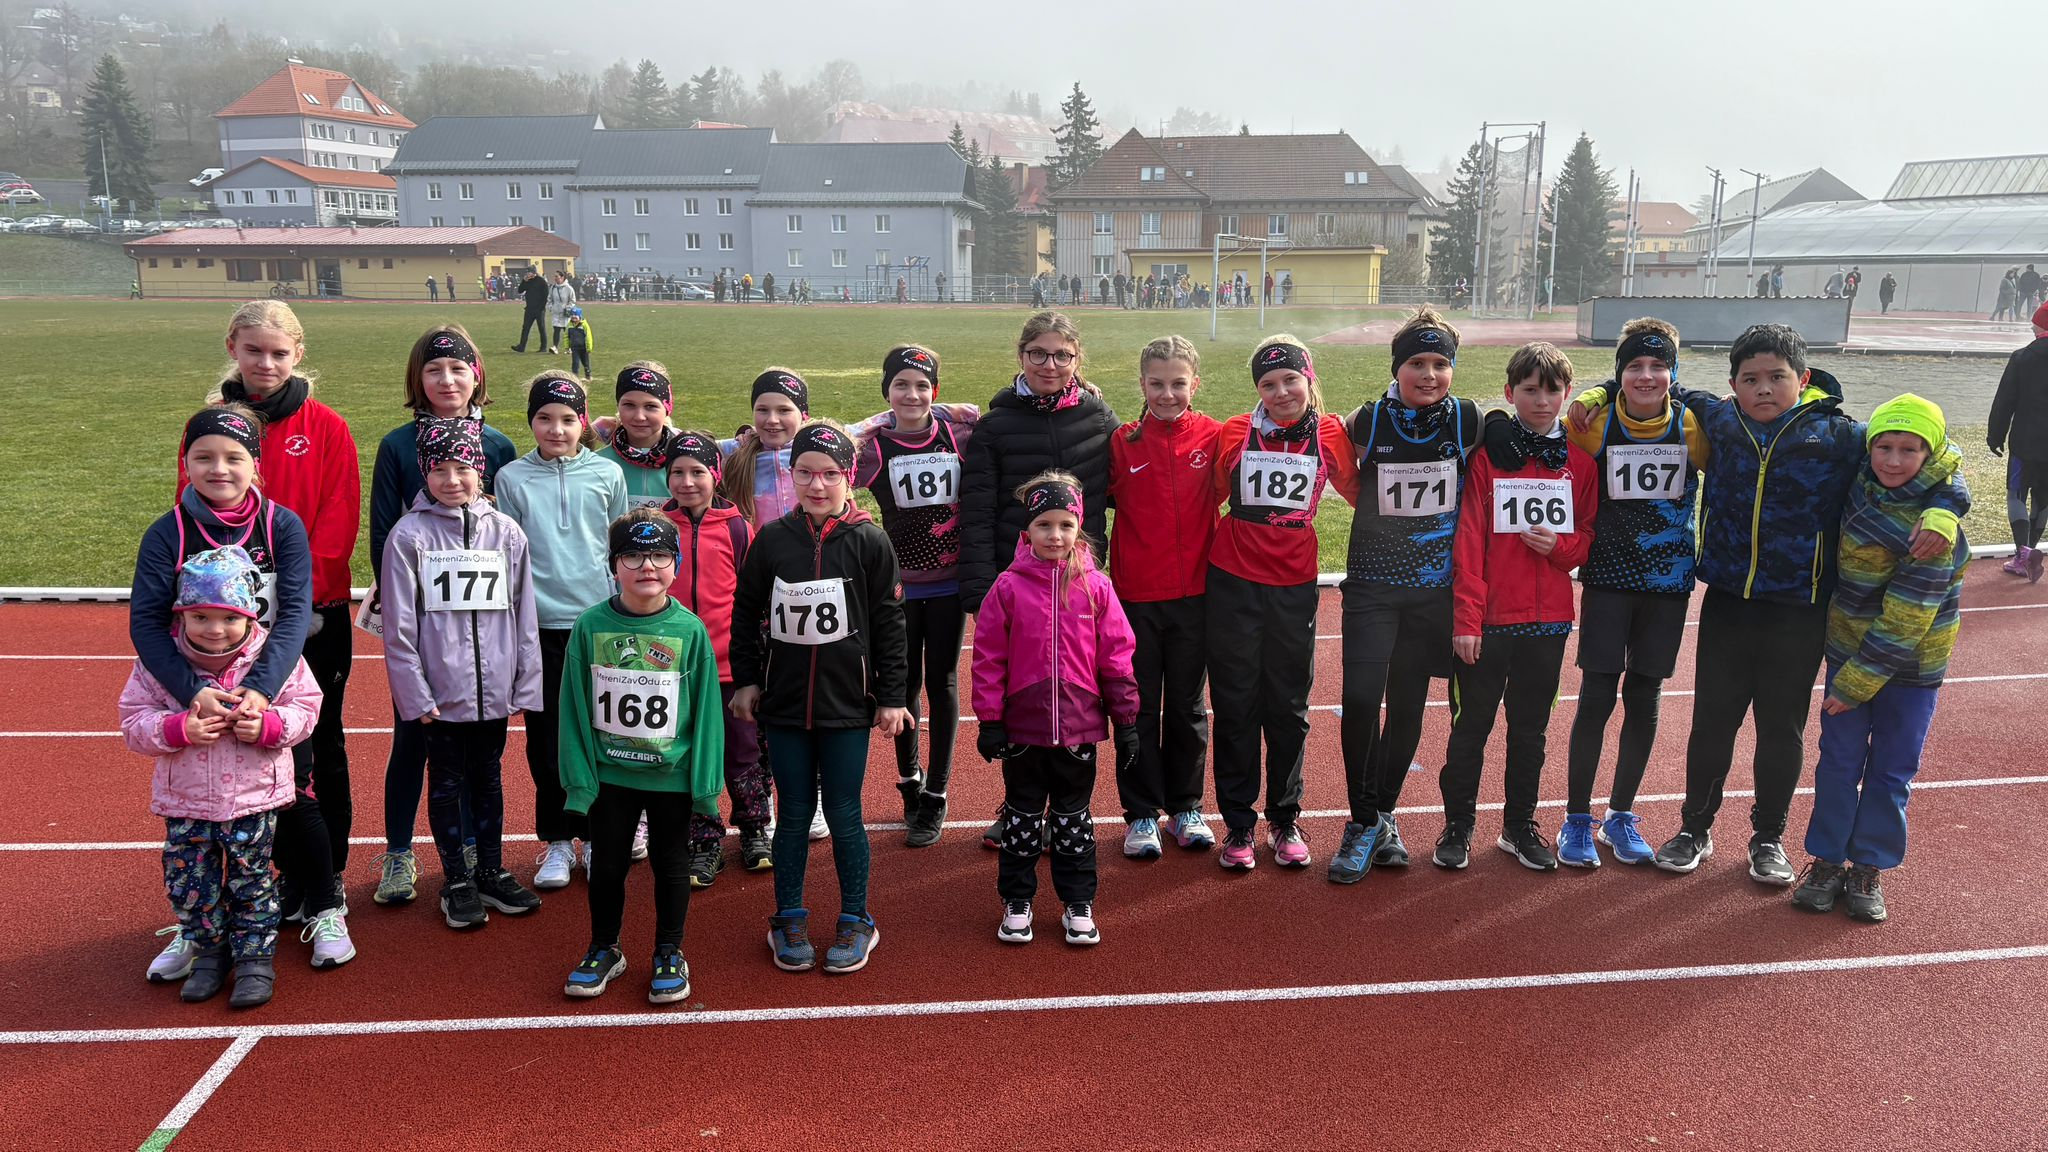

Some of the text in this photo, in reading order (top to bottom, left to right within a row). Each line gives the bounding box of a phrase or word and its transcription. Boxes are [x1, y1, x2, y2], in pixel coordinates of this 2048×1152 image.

[898, 469, 952, 501] 181
[1248, 470, 1308, 502] 182
[1615, 463, 1680, 492] 167
[1387, 479, 1446, 509] 171
[1502, 497, 1566, 525] 166
[434, 571, 499, 602] 177
[775, 602, 839, 636] 178
[598, 691, 669, 729] 168
[607, 748, 663, 763] MINECRAFT
